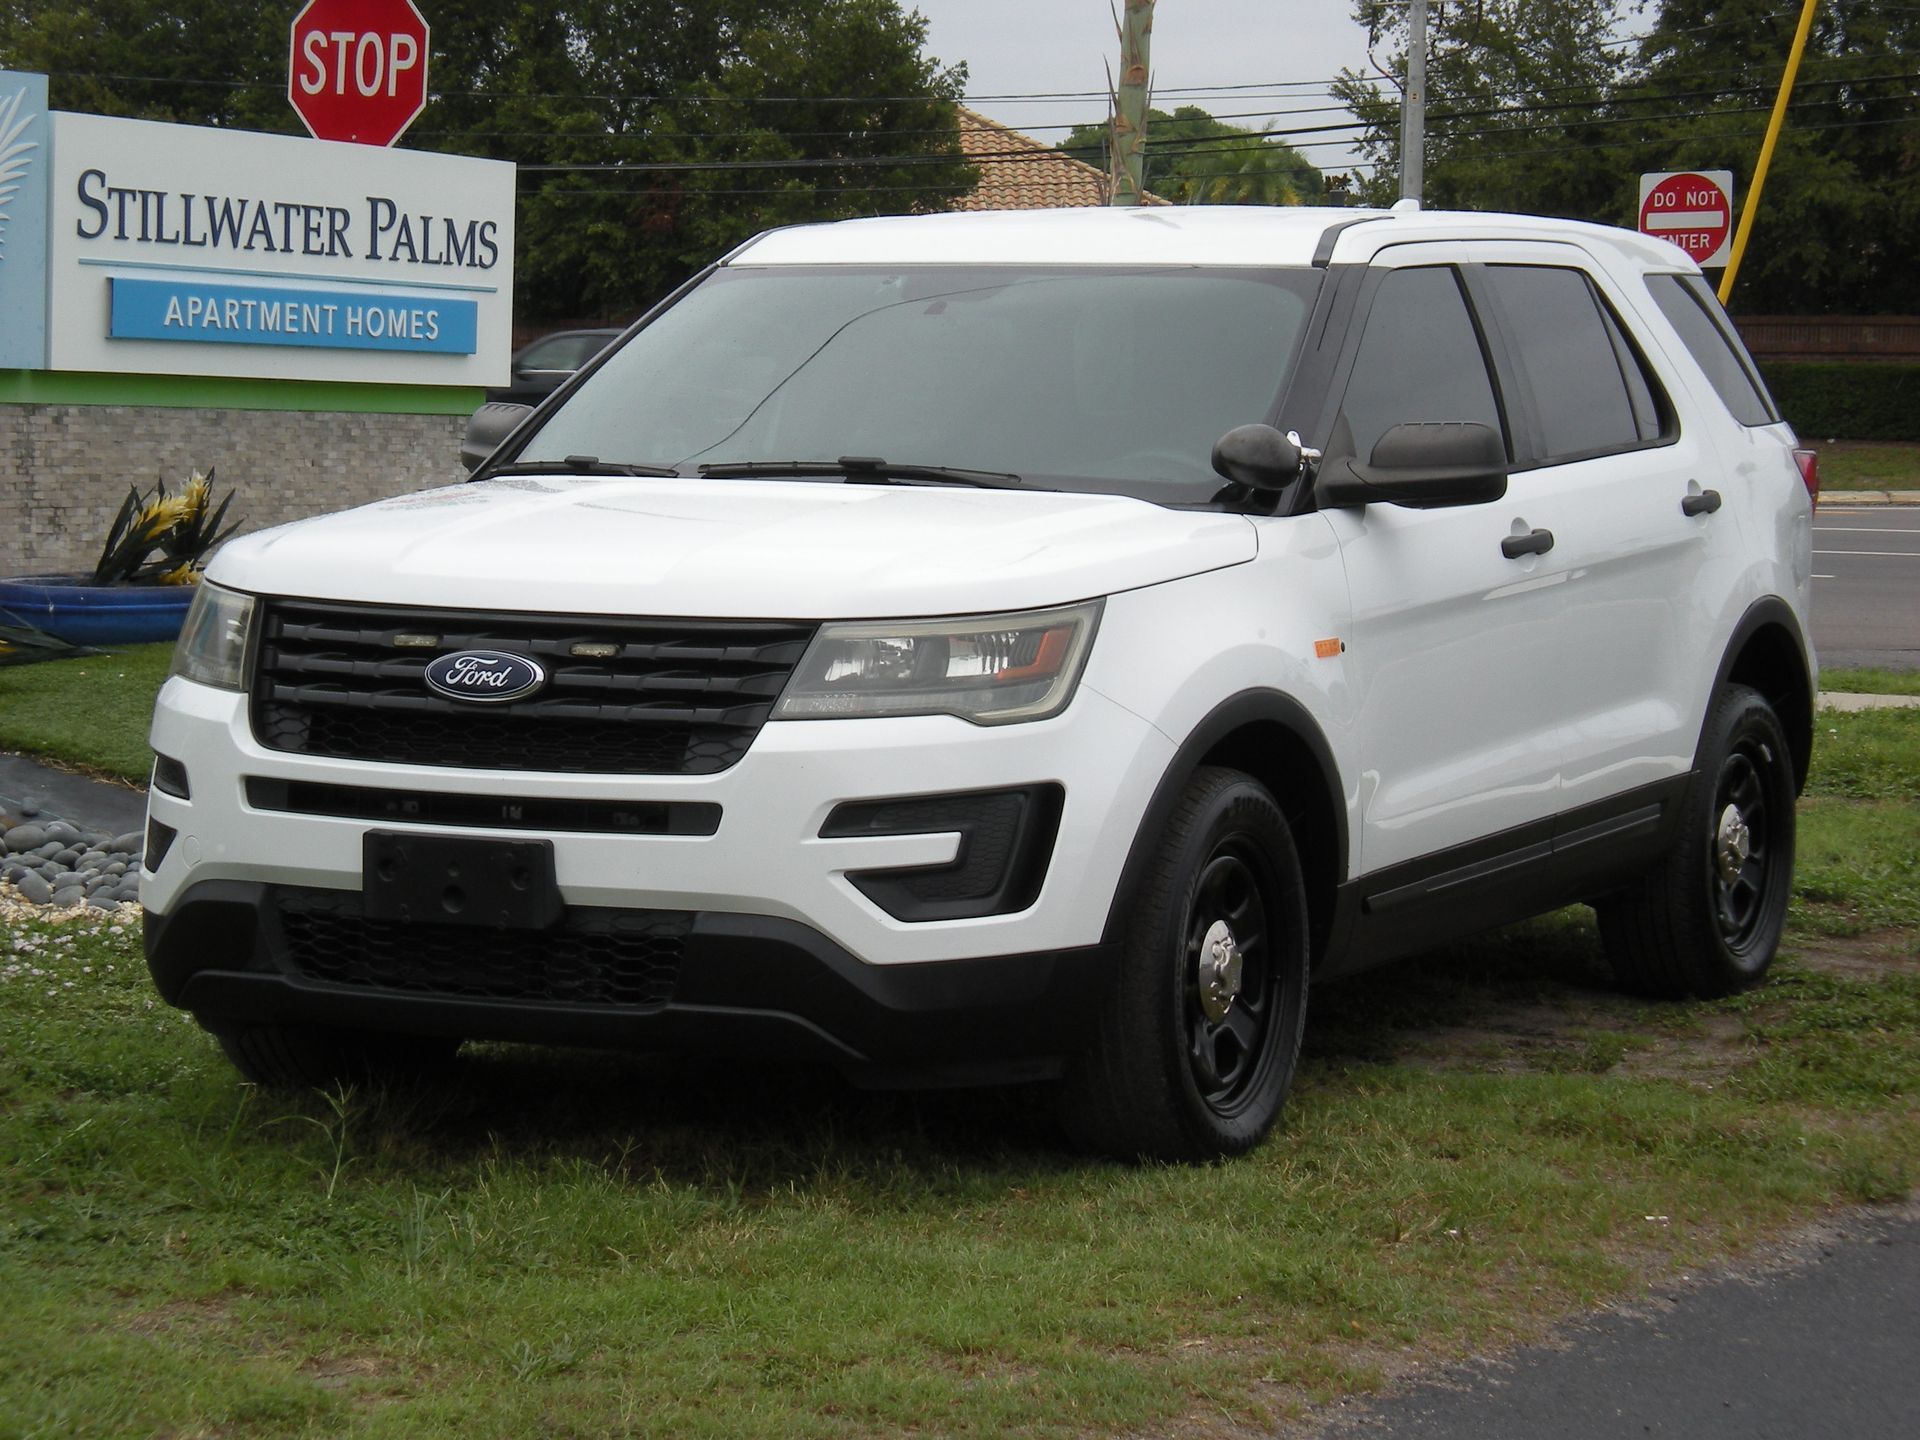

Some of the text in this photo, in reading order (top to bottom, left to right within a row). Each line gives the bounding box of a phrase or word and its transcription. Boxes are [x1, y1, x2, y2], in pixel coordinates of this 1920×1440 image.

[300, 30, 418, 97] STOP
[77, 169, 499, 269] STILLWATER PALMS
[1654, 191, 1718, 207] DO NOT
[164, 295, 439, 341] APARTMENT HOMES
[445, 656, 513, 687] Ford
